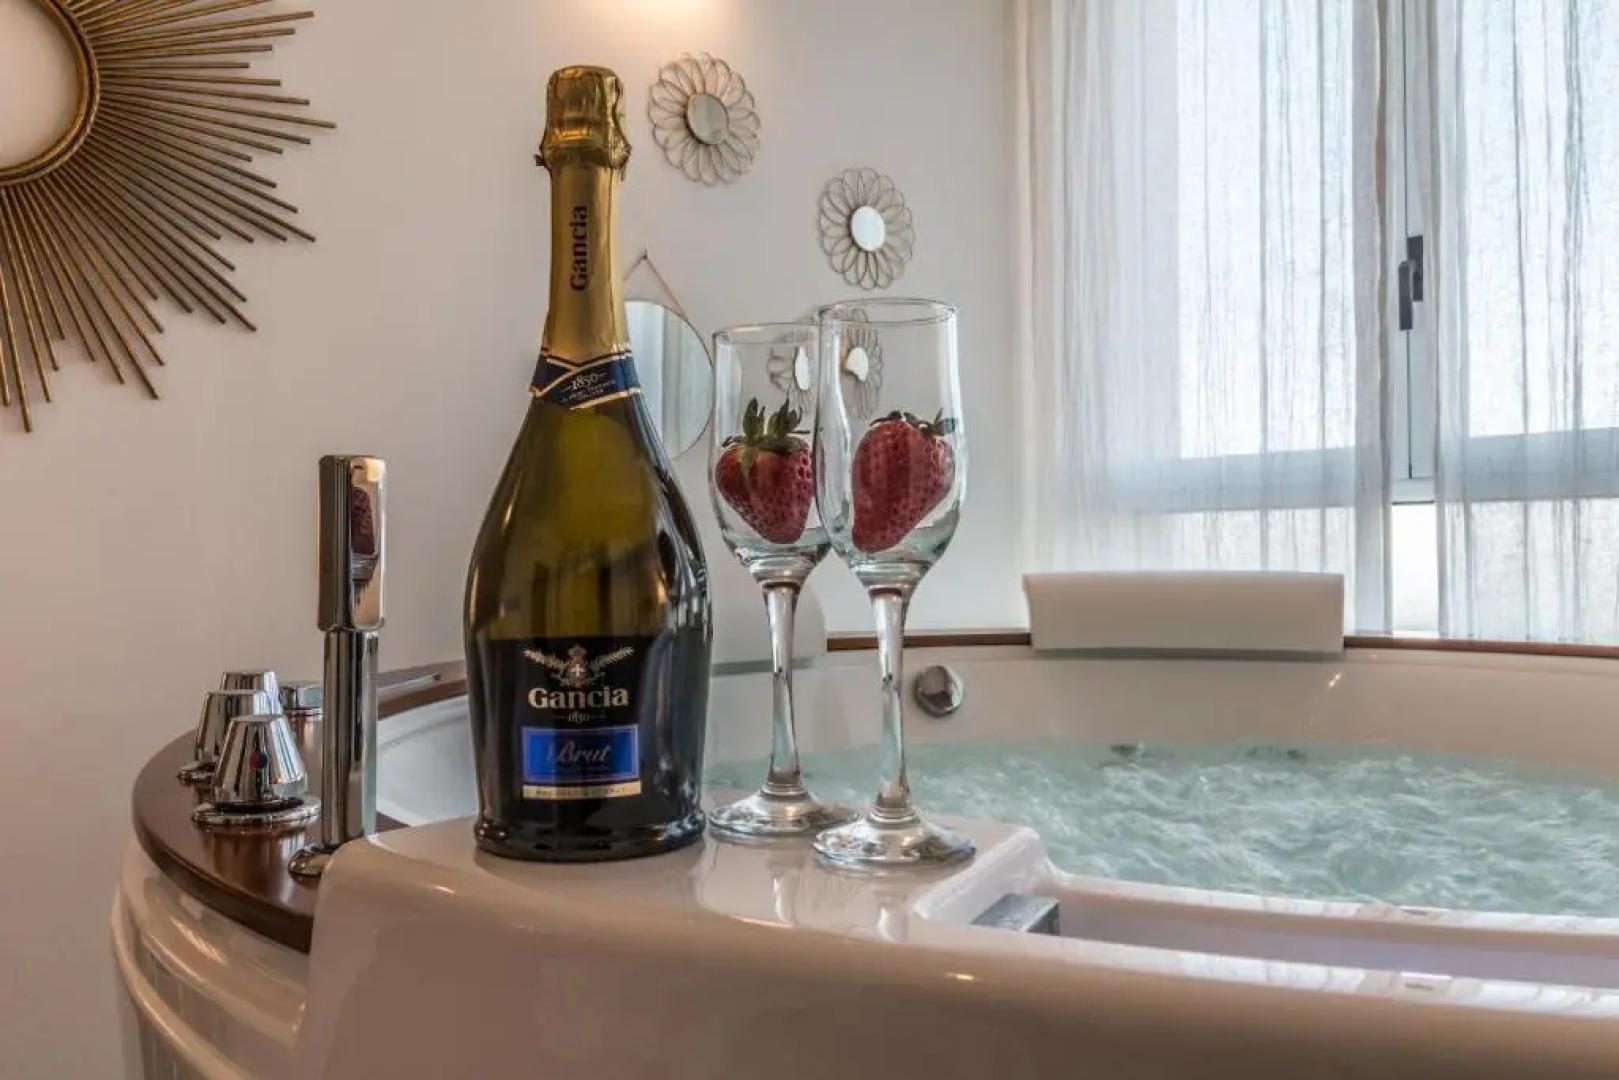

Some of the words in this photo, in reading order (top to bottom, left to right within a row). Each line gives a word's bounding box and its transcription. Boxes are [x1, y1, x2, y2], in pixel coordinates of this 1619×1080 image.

[569, 205, 587, 291] Gancia
[528, 686, 629, 709] Gancia
[549, 740, 611, 763] Brut
